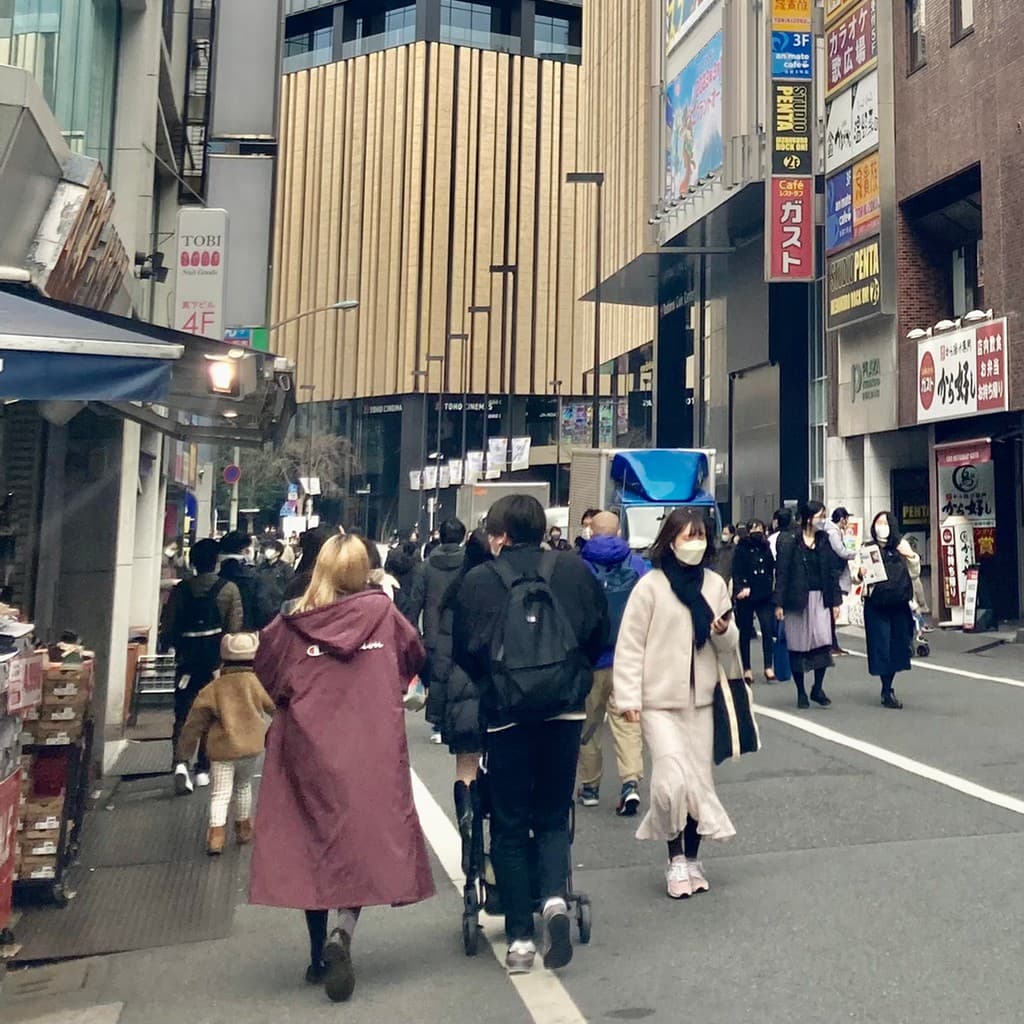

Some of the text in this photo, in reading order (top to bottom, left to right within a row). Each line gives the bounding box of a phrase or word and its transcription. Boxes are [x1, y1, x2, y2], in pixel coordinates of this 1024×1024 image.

[792, 34, 809, 47] 3F
[829, 7, 868, 57] カラオケ
[831, 35, 866, 84] 歌広場
[777, 85, 793, 132] PENTA
[792, 85, 807, 133] STUDIO
[779, 179, 804, 190] Café
[181, 234, 221, 247] TOBI
[780, 199, 803, 274] ガスト
[854, 243, 879, 282] PENTA
[182, 311, 215, 335] 4F
[937, 360, 976, 405] から好し
[981, 358, 1000, 378] お弁当
[444, 403, 463, 411] TOHO
